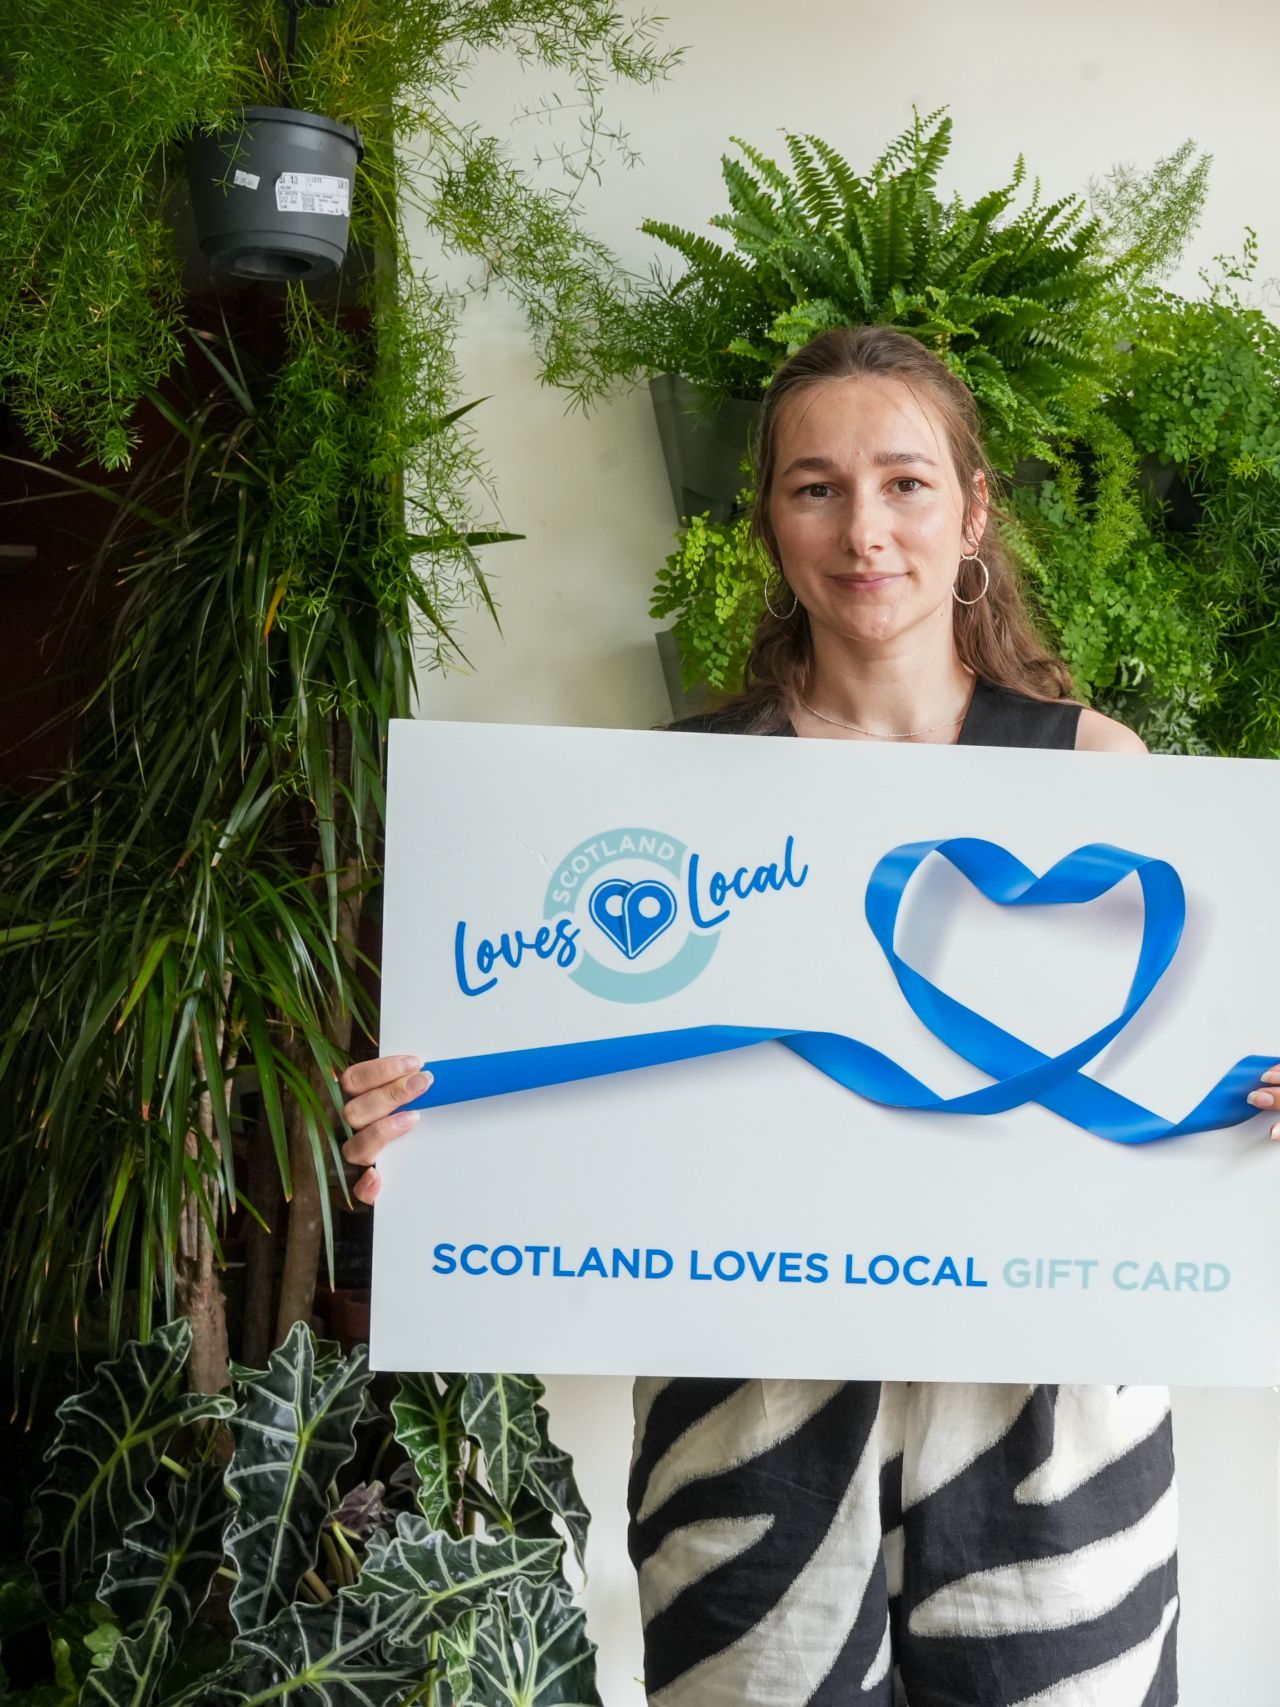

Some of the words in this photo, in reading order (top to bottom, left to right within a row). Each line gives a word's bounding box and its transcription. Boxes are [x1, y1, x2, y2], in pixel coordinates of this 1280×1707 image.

[552, 834, 676, 905] SCOTLAND
[455, 918, 581, 997] Loves
[688, 835, 809, 929] Local
[431, 1242, 674, 1280] SCOTLAND
[689, 1249, 829, 1285] LOVES
[845, 1253, 988, 1288] LOCAL
[1002, 1257, 1098, 1290] GIFT
[1112, 1260, 1232, 1293] CARD
